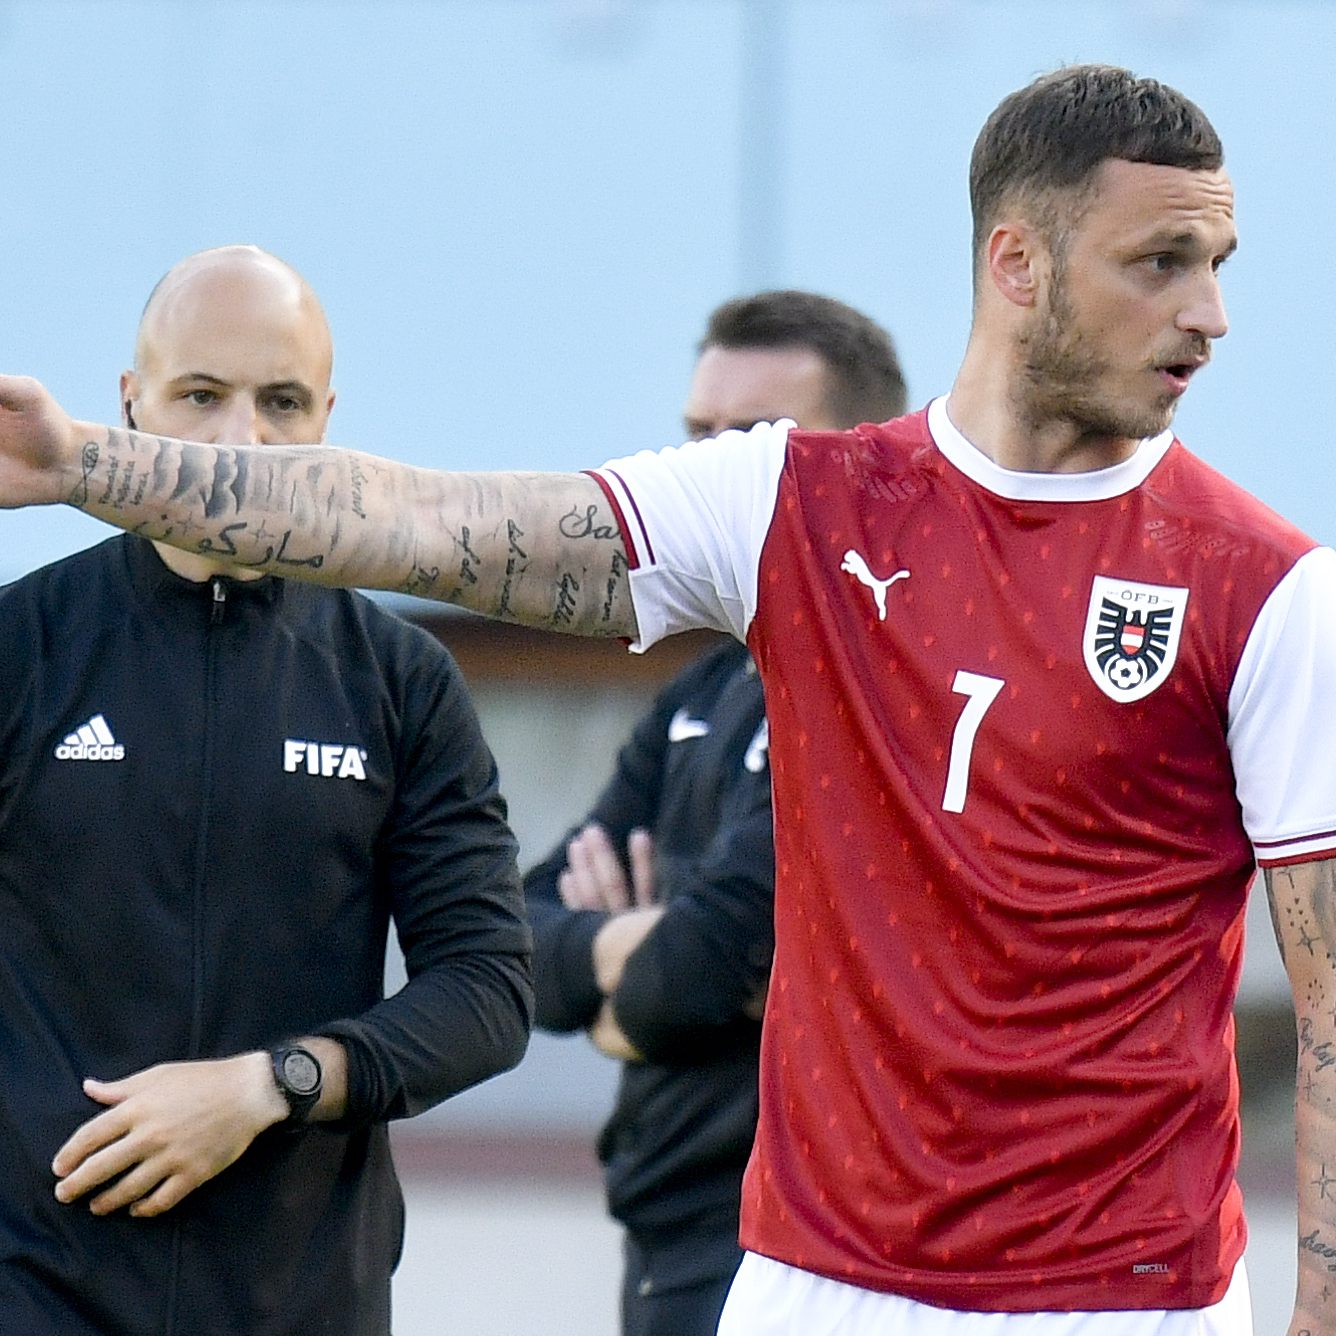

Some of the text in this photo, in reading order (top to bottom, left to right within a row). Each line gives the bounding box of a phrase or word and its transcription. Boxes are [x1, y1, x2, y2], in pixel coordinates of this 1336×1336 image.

[558, 504, 621, 539] Sa
[55, 743, 126, 761] adidas
[283, 739, 367, 781] FIFA
[941, 670, 1006, 815] 7
